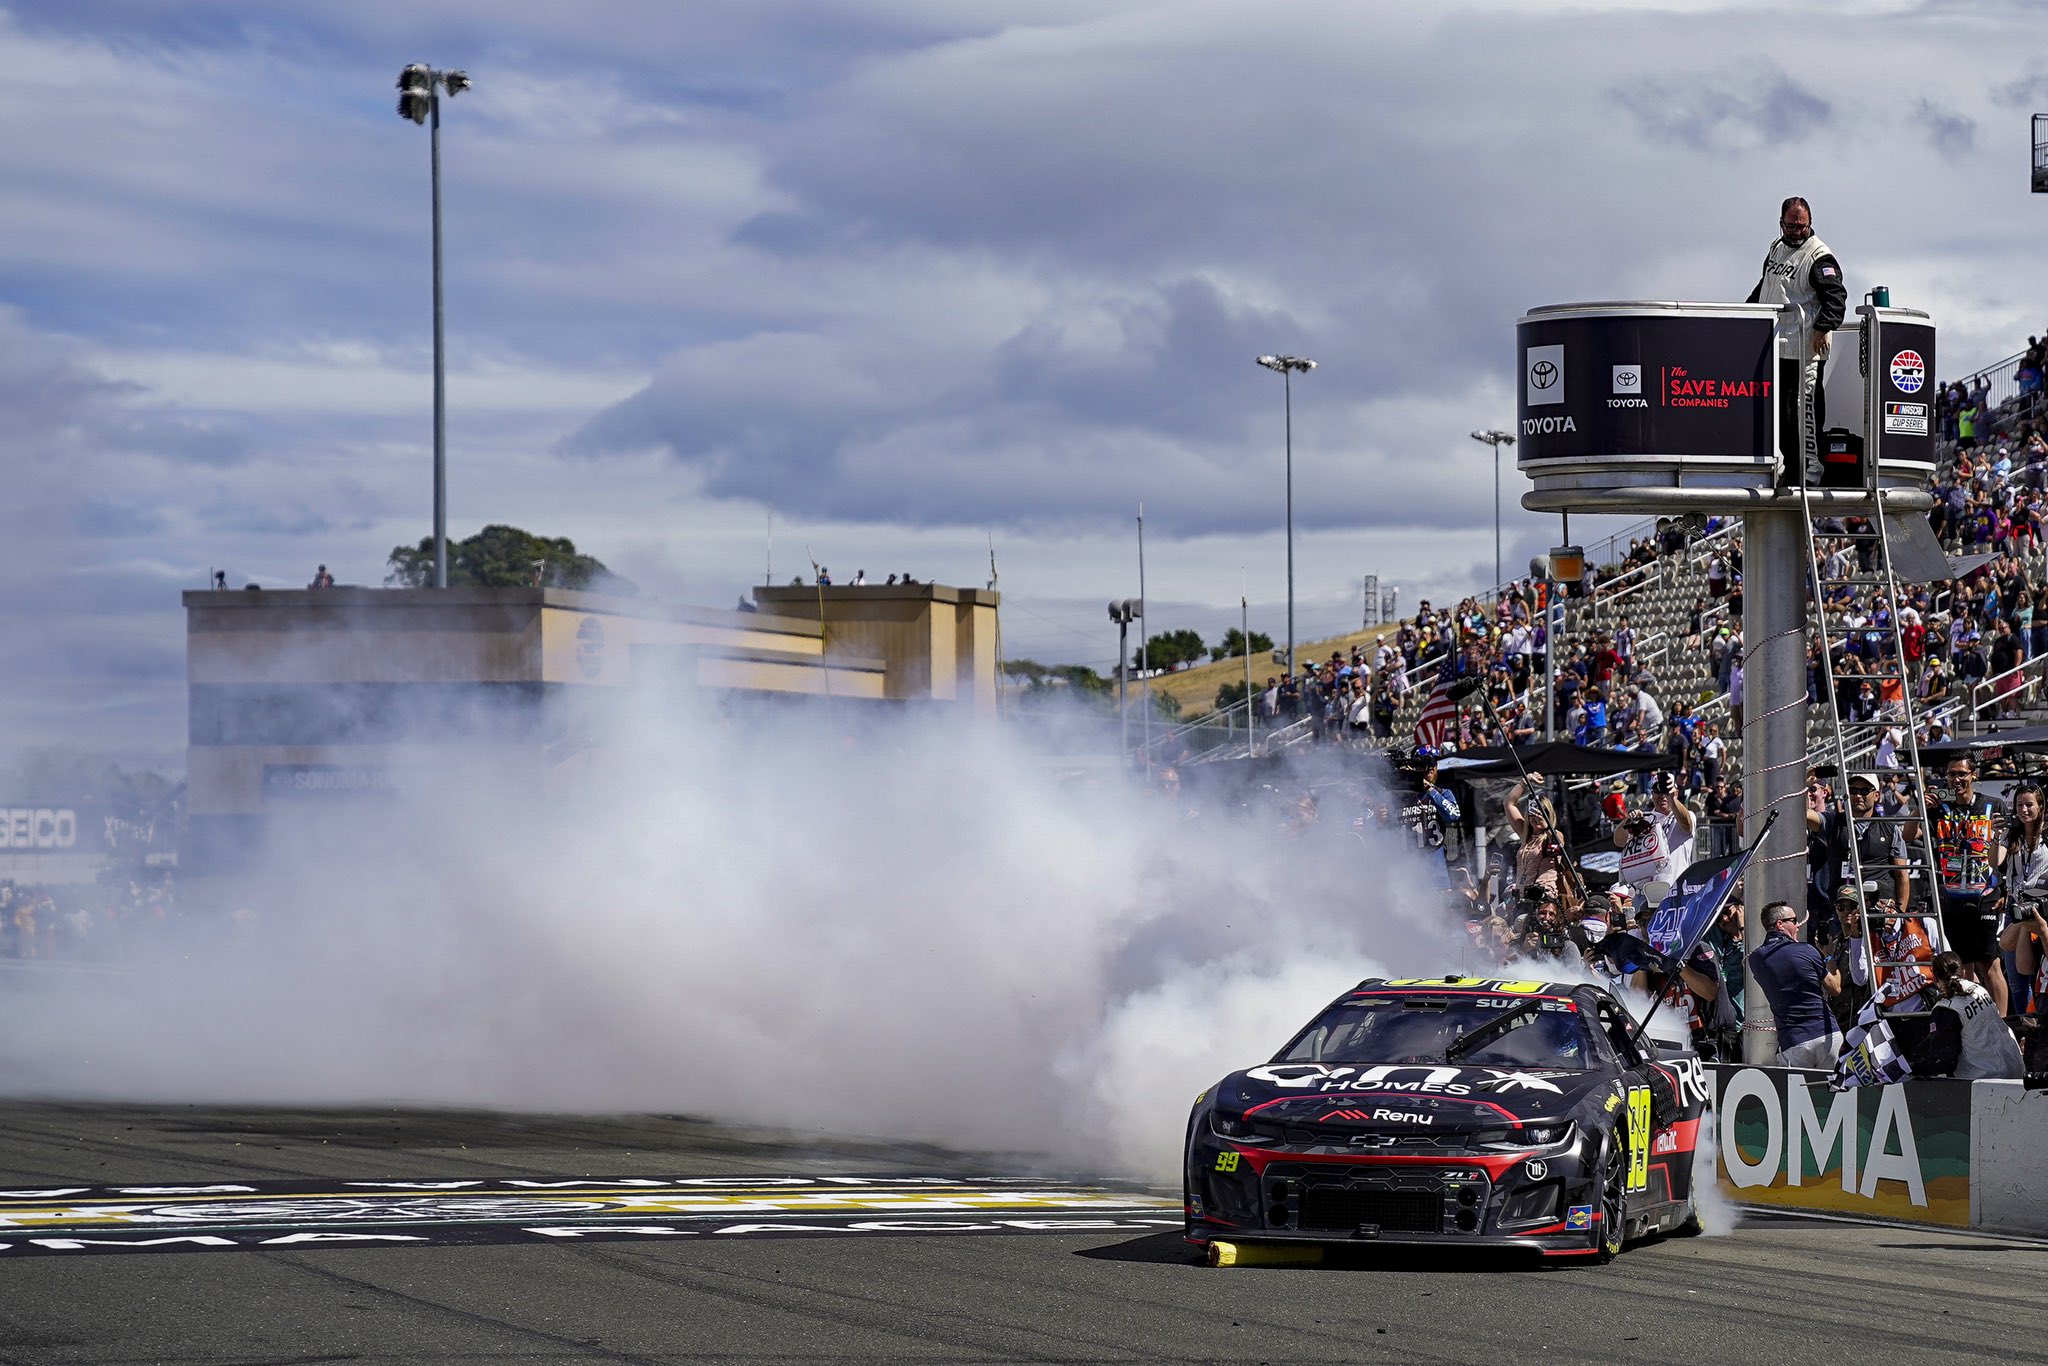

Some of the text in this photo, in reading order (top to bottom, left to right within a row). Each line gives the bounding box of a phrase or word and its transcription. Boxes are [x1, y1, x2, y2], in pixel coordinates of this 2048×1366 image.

[1671, 366, 1688, 377] The
[1671, 380, 1771, 397] SAVE MART
[1607, 399, 1649, 409] TOYOTA
[1671, 398, 1729, 408] COMPANIES
[1900, 404, 1924, 416] NASCAR
[1522, 415, 1577, 436] TOYOTA
[1892, 418, 1924, 429] CUP SERIES
[1320, 1080, 1472, 1095] HOMES
[1373, 1109, 1434, 1126] Renu
[1703, 1067, 1929, 1208] OMA
[1215, 1152, 1240, 1173] 99
